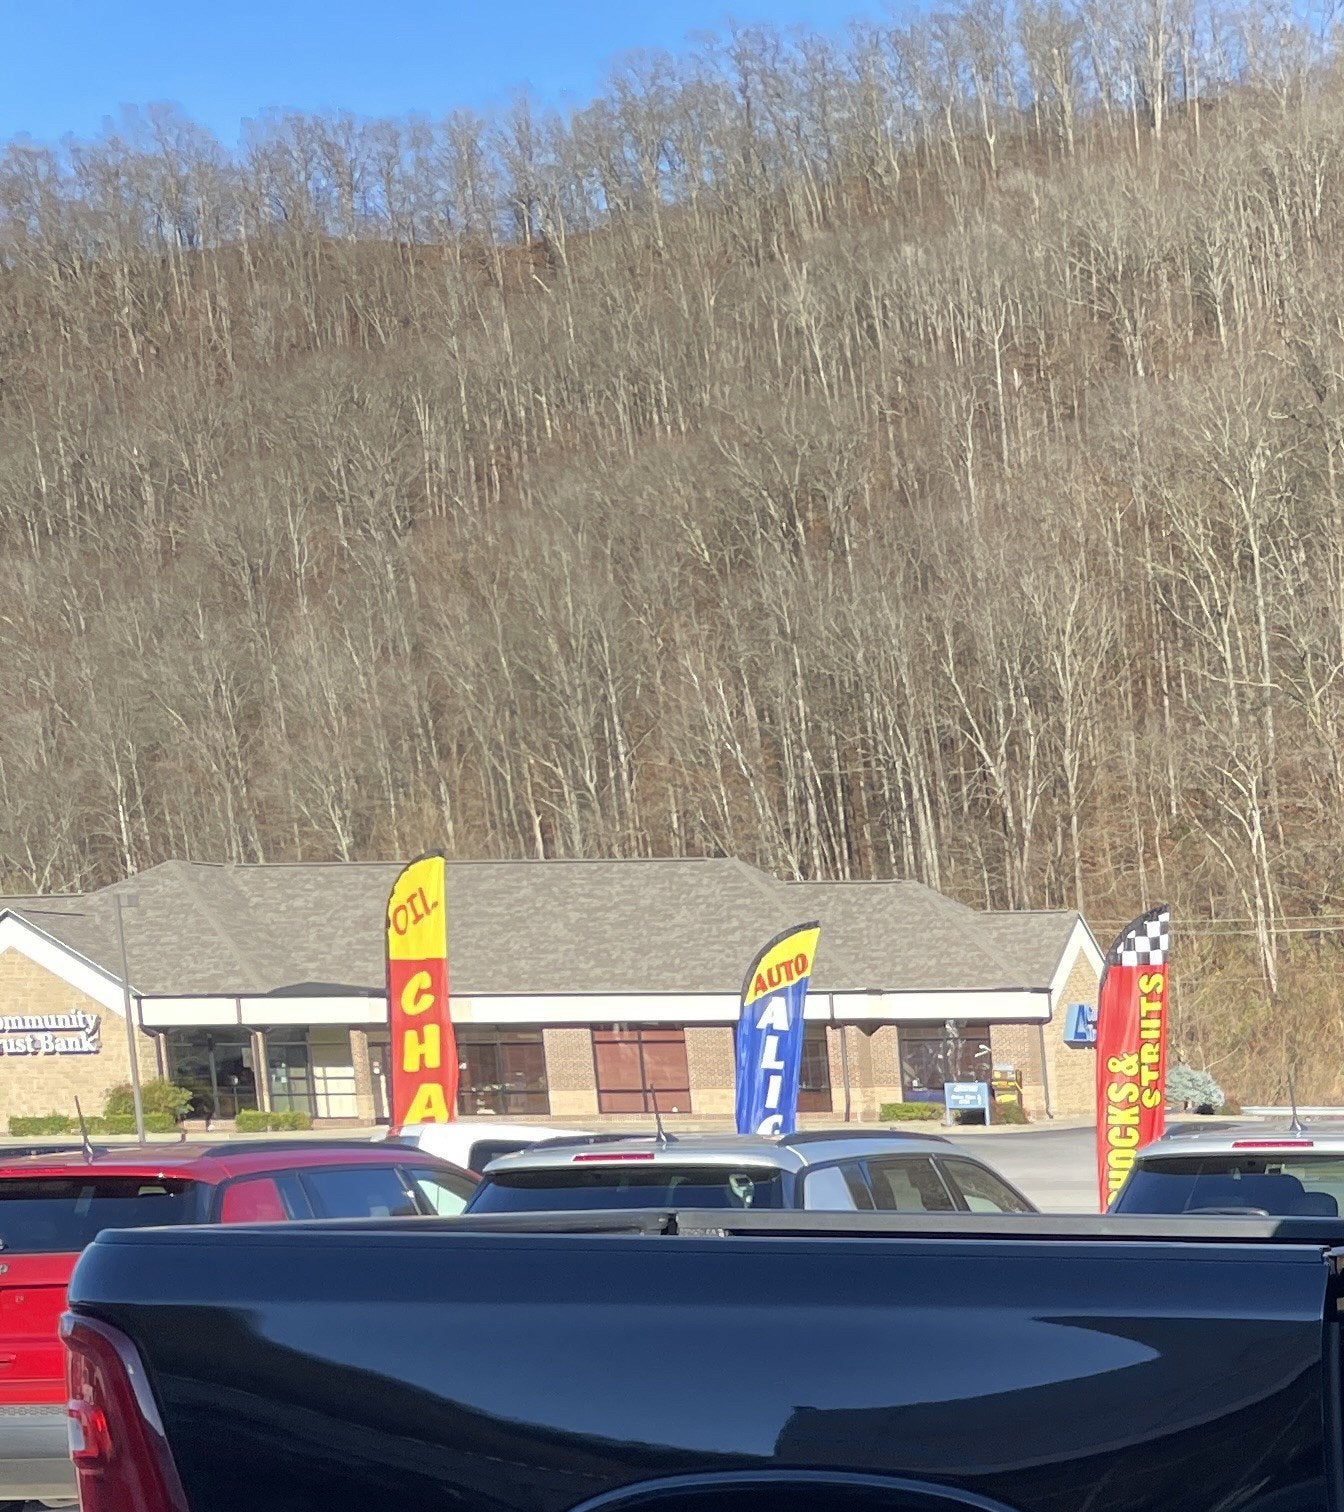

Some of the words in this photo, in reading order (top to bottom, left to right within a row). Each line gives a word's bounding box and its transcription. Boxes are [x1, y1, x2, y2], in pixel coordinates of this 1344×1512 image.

[392, 887, 439, 935] OIL
[754, 953, 809, 996] AUTO
[38, 1031, 99, 1053] Bank
[1138, 972, 1164, 1109] STRUTS
[1106, 1051, 1140, 1078] &
